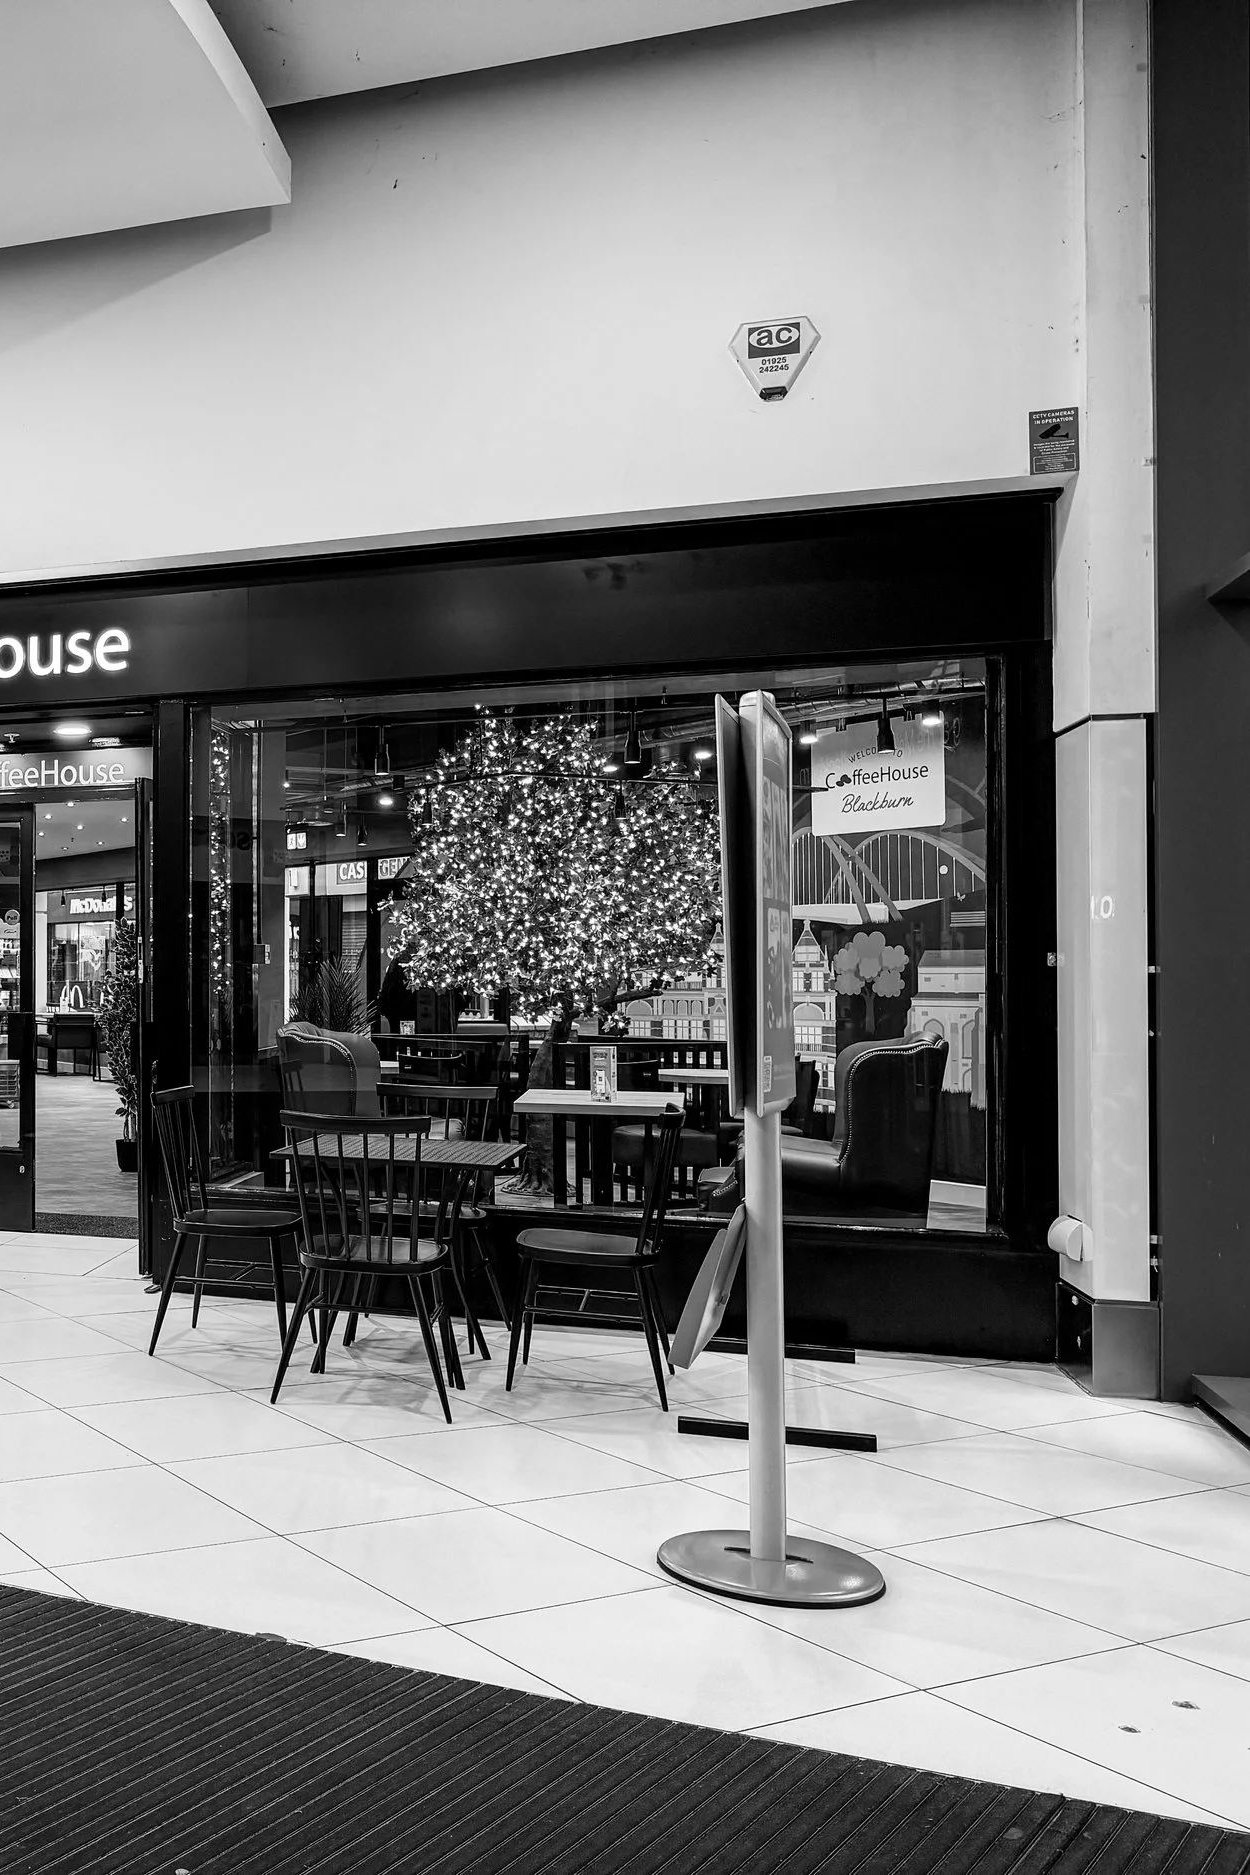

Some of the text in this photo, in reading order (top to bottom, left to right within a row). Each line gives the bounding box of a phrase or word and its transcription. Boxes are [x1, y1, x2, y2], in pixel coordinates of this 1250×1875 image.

[756, 327, 792, 346] ac
[759, 364, 790, 374] 242245
[761, 356, 787, 366] 01925
[841, 791, 914, 814] Blackburn
[339, 861, 367, 880] CAS
